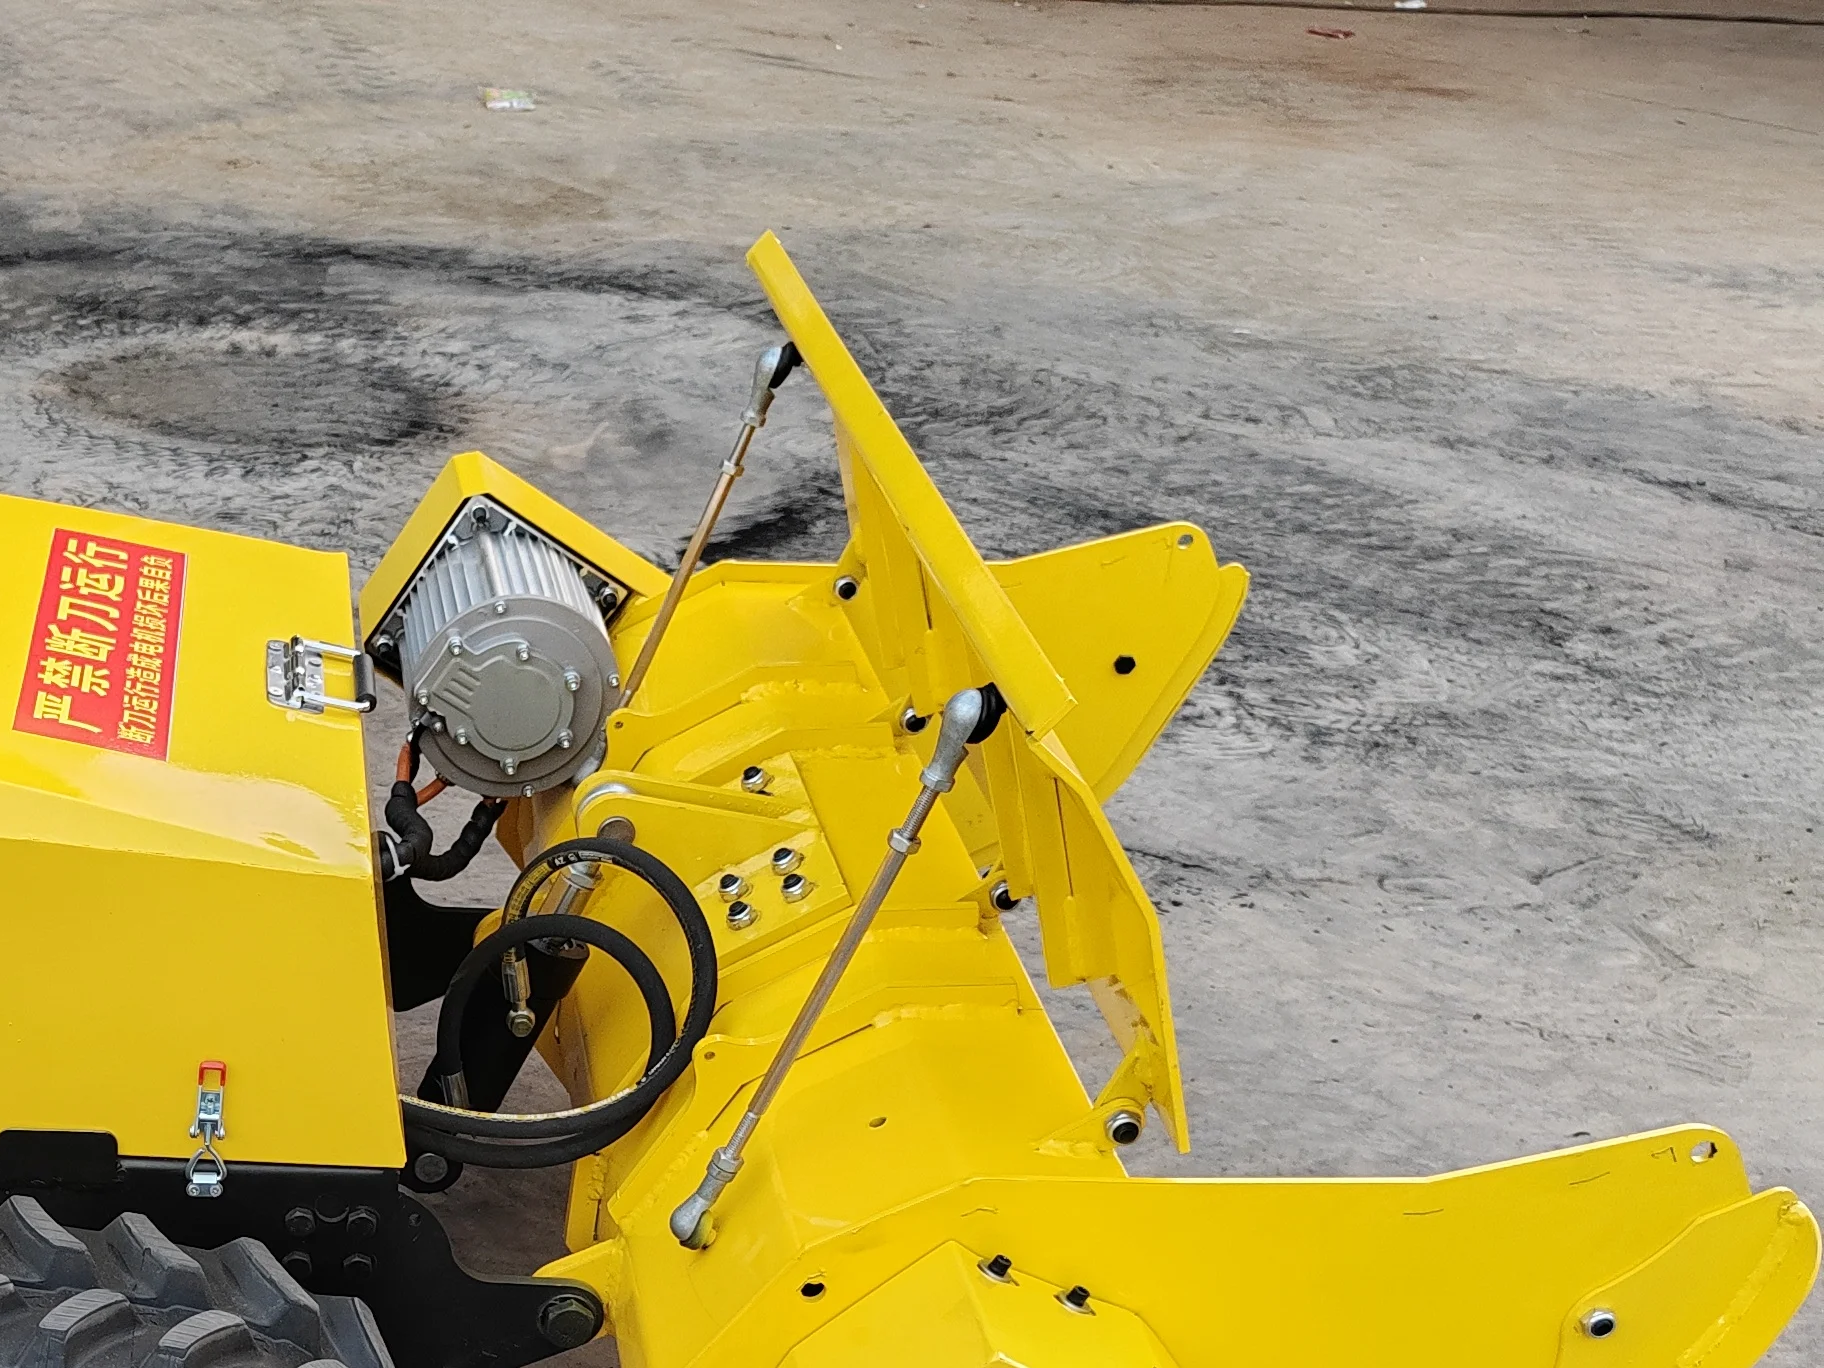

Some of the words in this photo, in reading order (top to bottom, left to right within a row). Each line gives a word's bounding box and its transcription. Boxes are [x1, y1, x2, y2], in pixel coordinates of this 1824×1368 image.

[33, 538, 130, 734] 严禁断刀运行
[117, 554, 174, 745] 断刀运行造成电机损坏后果自负
